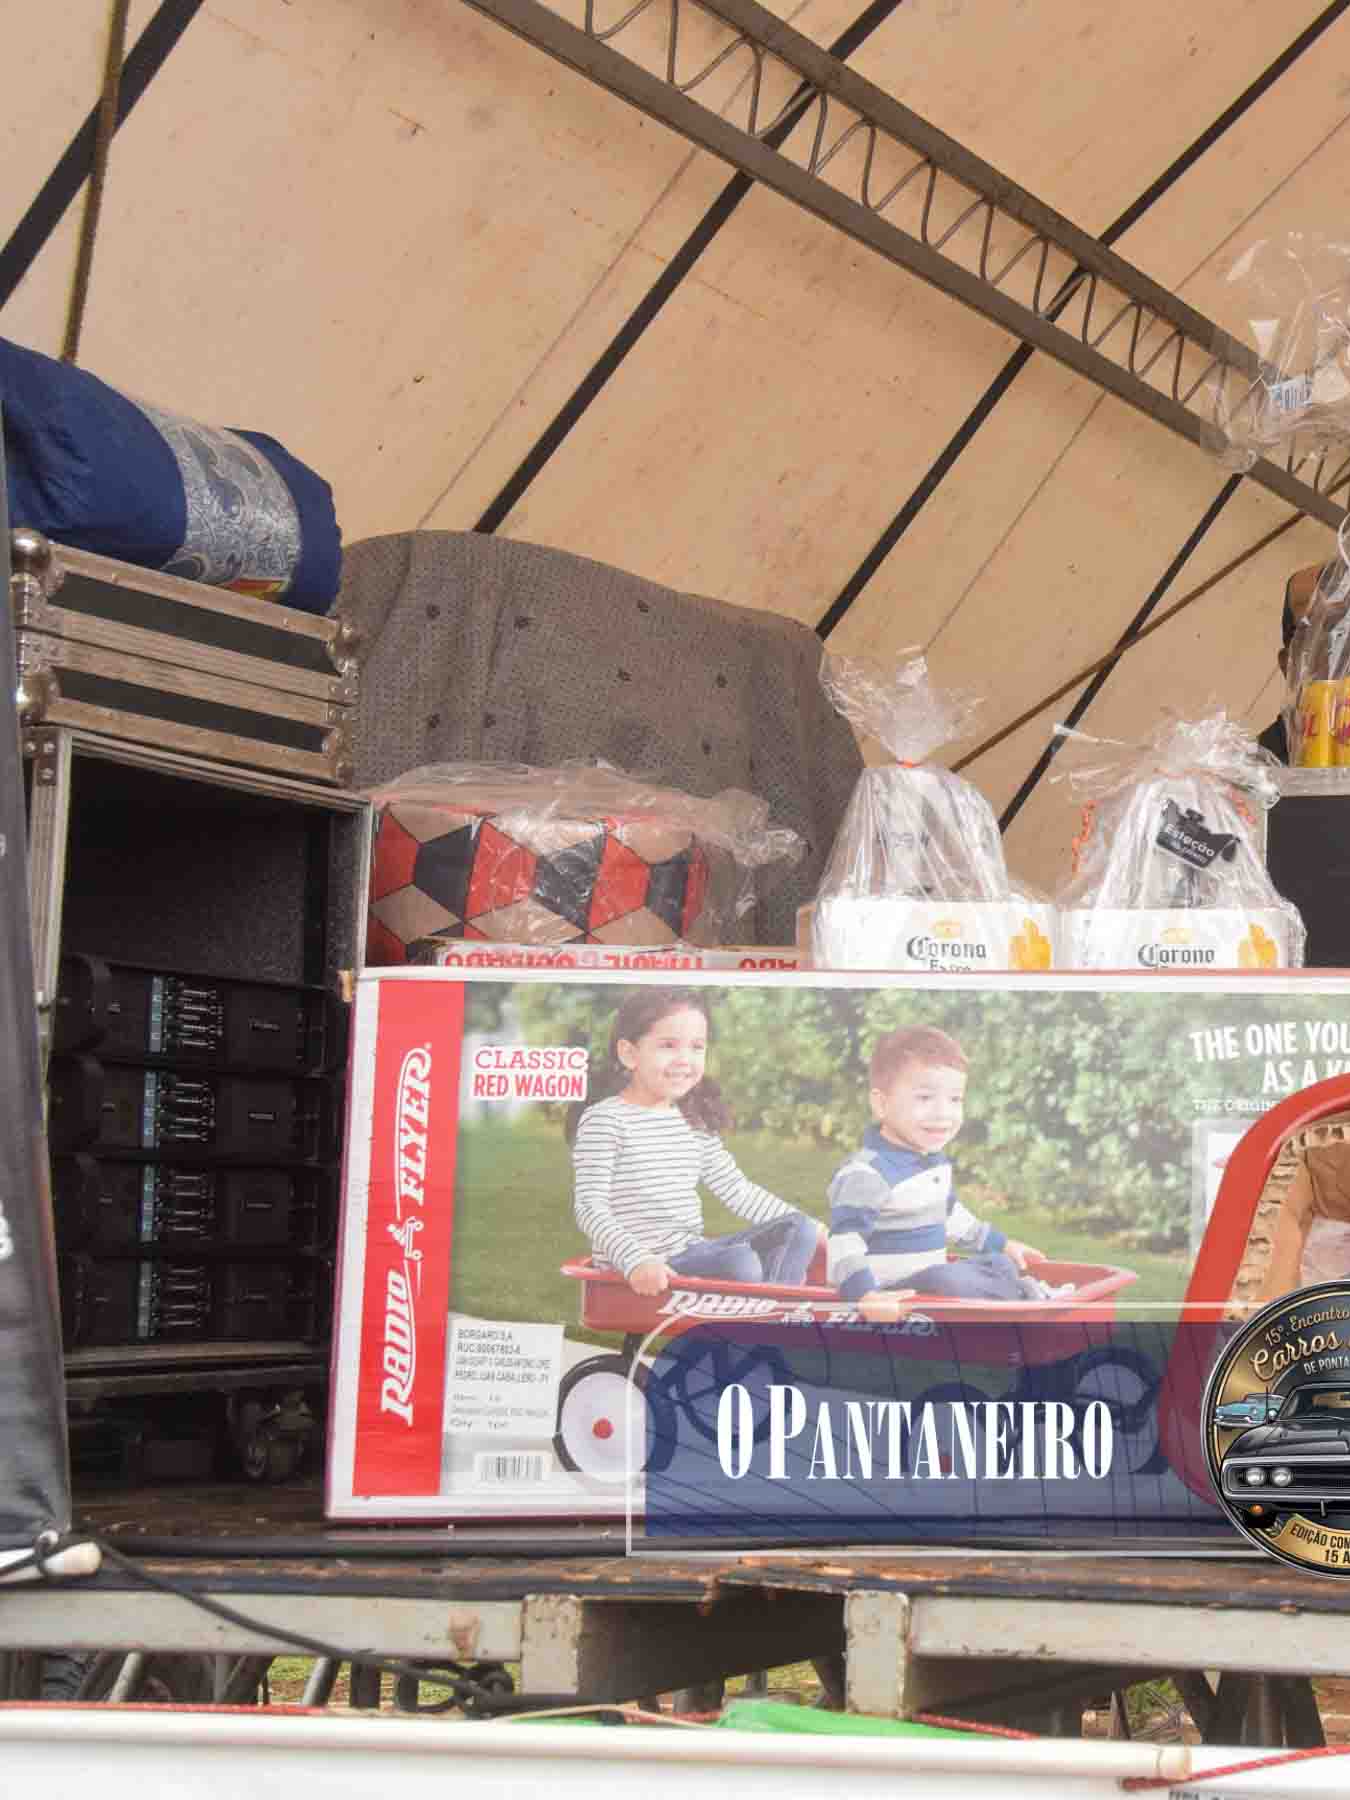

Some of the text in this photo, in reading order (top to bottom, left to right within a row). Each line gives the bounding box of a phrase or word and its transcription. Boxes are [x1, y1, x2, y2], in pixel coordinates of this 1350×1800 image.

[904, 935, 989, 964] Corona
[1137, 943, 1217, 968] Corona
[1189, 1026, 1240, 1063] THE
[1246, 1022, 1298, 1056] ONE
[475, 1050, 586, 1070] CLASSIC
[473, 1073, 583, 1097] RED WAGON
[1263, 1059, 1295, 1094] AS
[379, 1266, 417, 1428] RADIO
